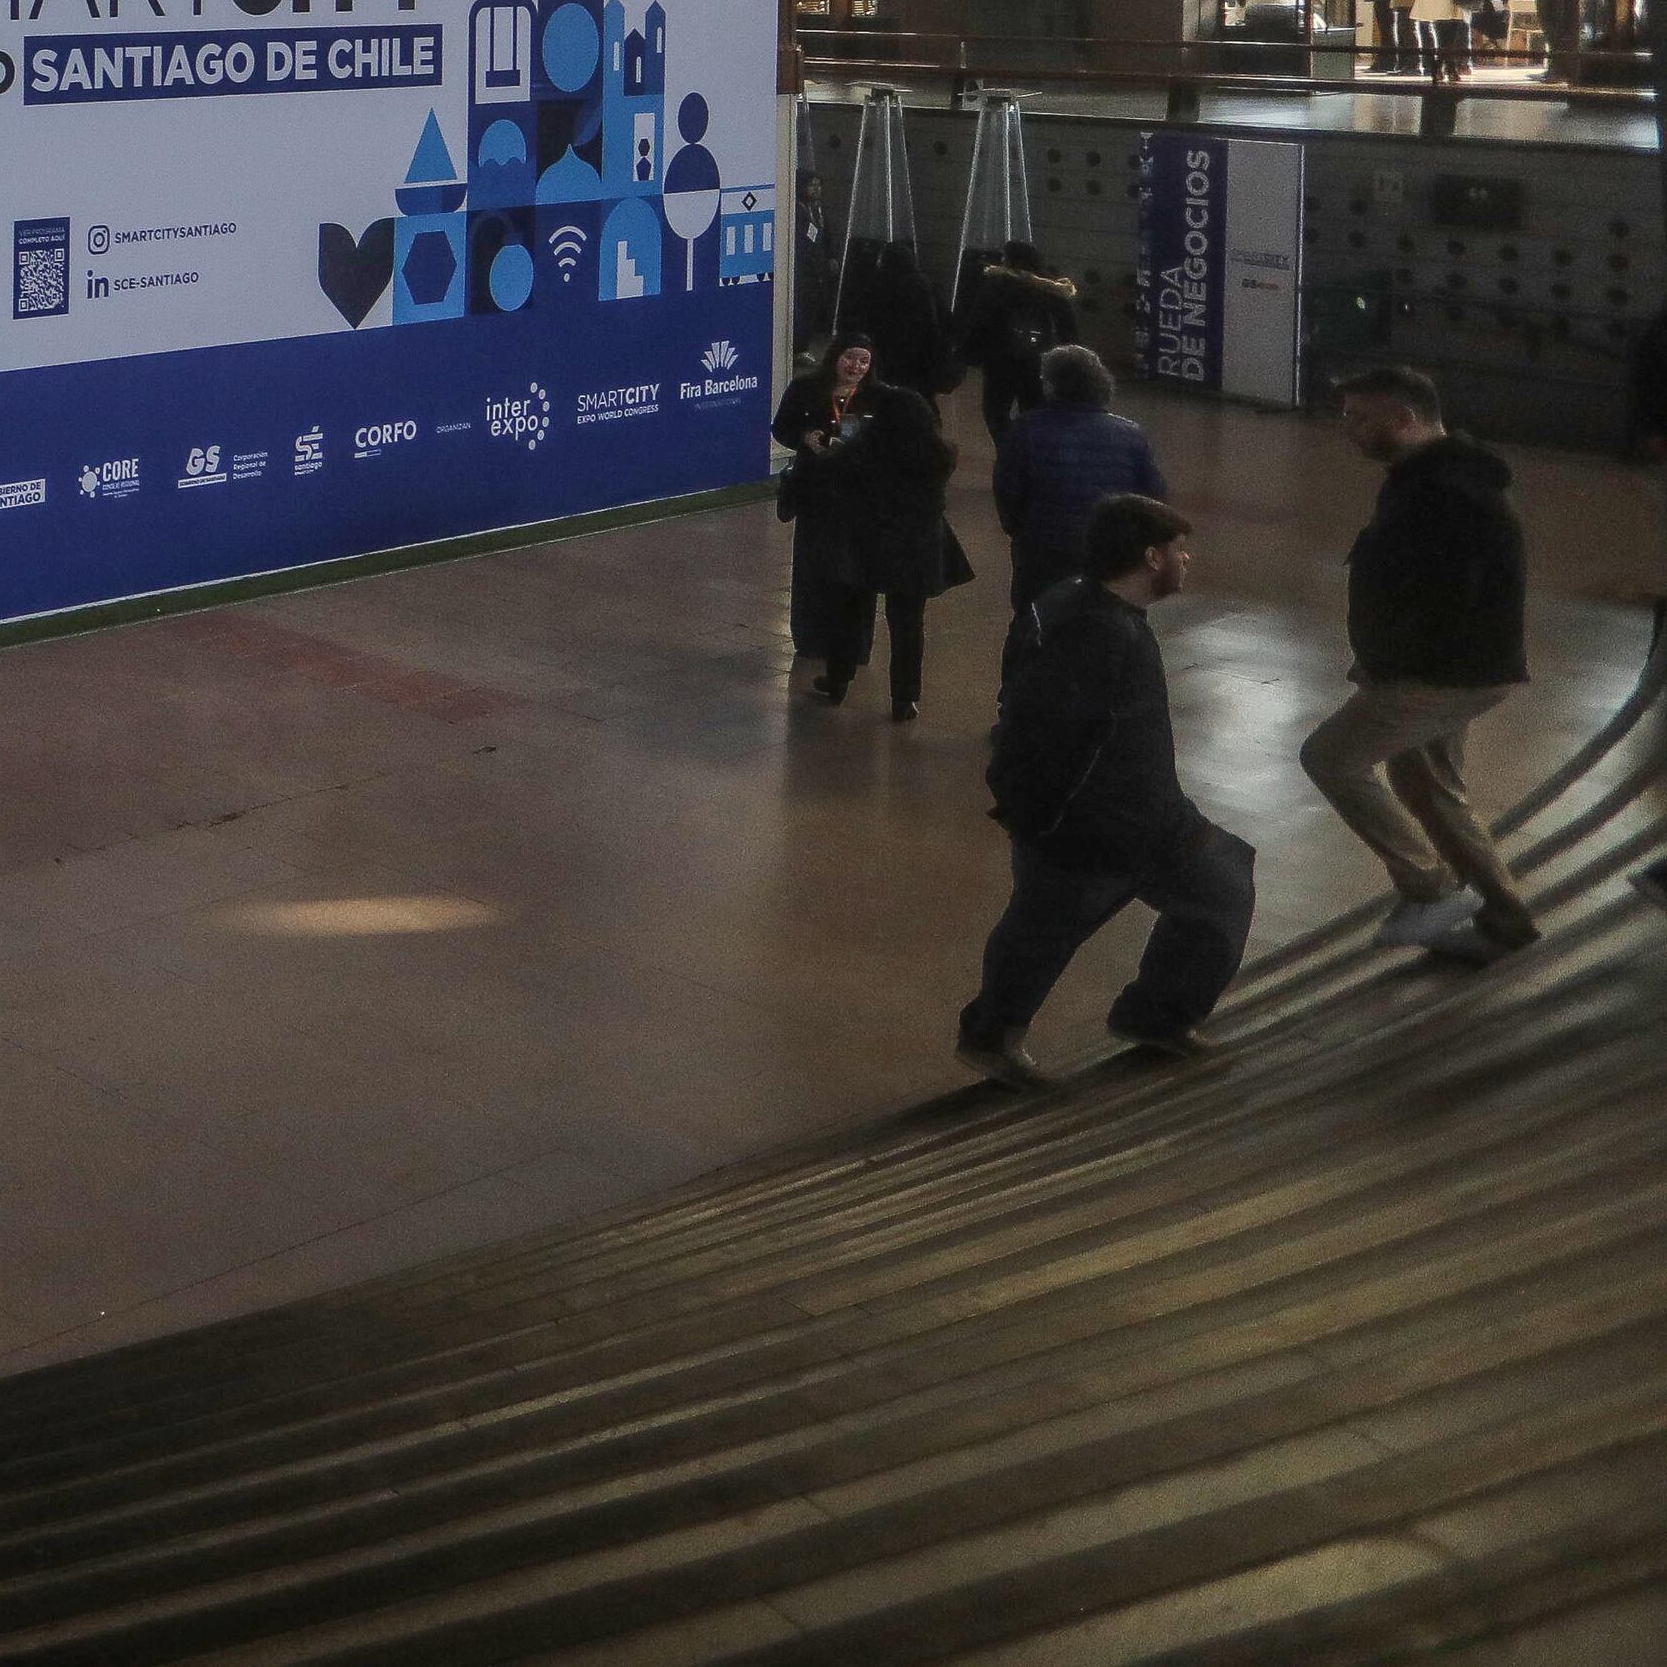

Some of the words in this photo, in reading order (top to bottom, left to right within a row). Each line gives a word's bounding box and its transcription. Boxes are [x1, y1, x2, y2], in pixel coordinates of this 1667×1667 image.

[31, 40, 256, 92] SANTIAGO
[266, 38, 319, 83] DE
[327, 34, 435, 79] CHILE
[114, 222, 237, 244] SMARTCITYSANTIAGO
[1183, 149, 1211, 327] NEGOCIOS
[113, 271, 200, 292] SCE-SANTIAGO
[1157, 265, 1185, 377] RUEDA
[1181, 335, 1206, 382] DE
[577, 384, 660, 412] SMARTCITY
[679, 382, 701, 400] Fira
[704, 374, 759, 396] Barcelona
[486, 396, 531, 421] inter
[576, 412, 596, 425] EXPO
[597, 409, 623, 421] WORLD
[623, 403, 660, 418] CONGRESS
[354, 420, 417, 449] CORFO
[490, 414, 538, 441] expo
[102, 457, 140, 482] CORE
[185, 444, 221, 476] GS
[30, 481, 42, 491] DE
